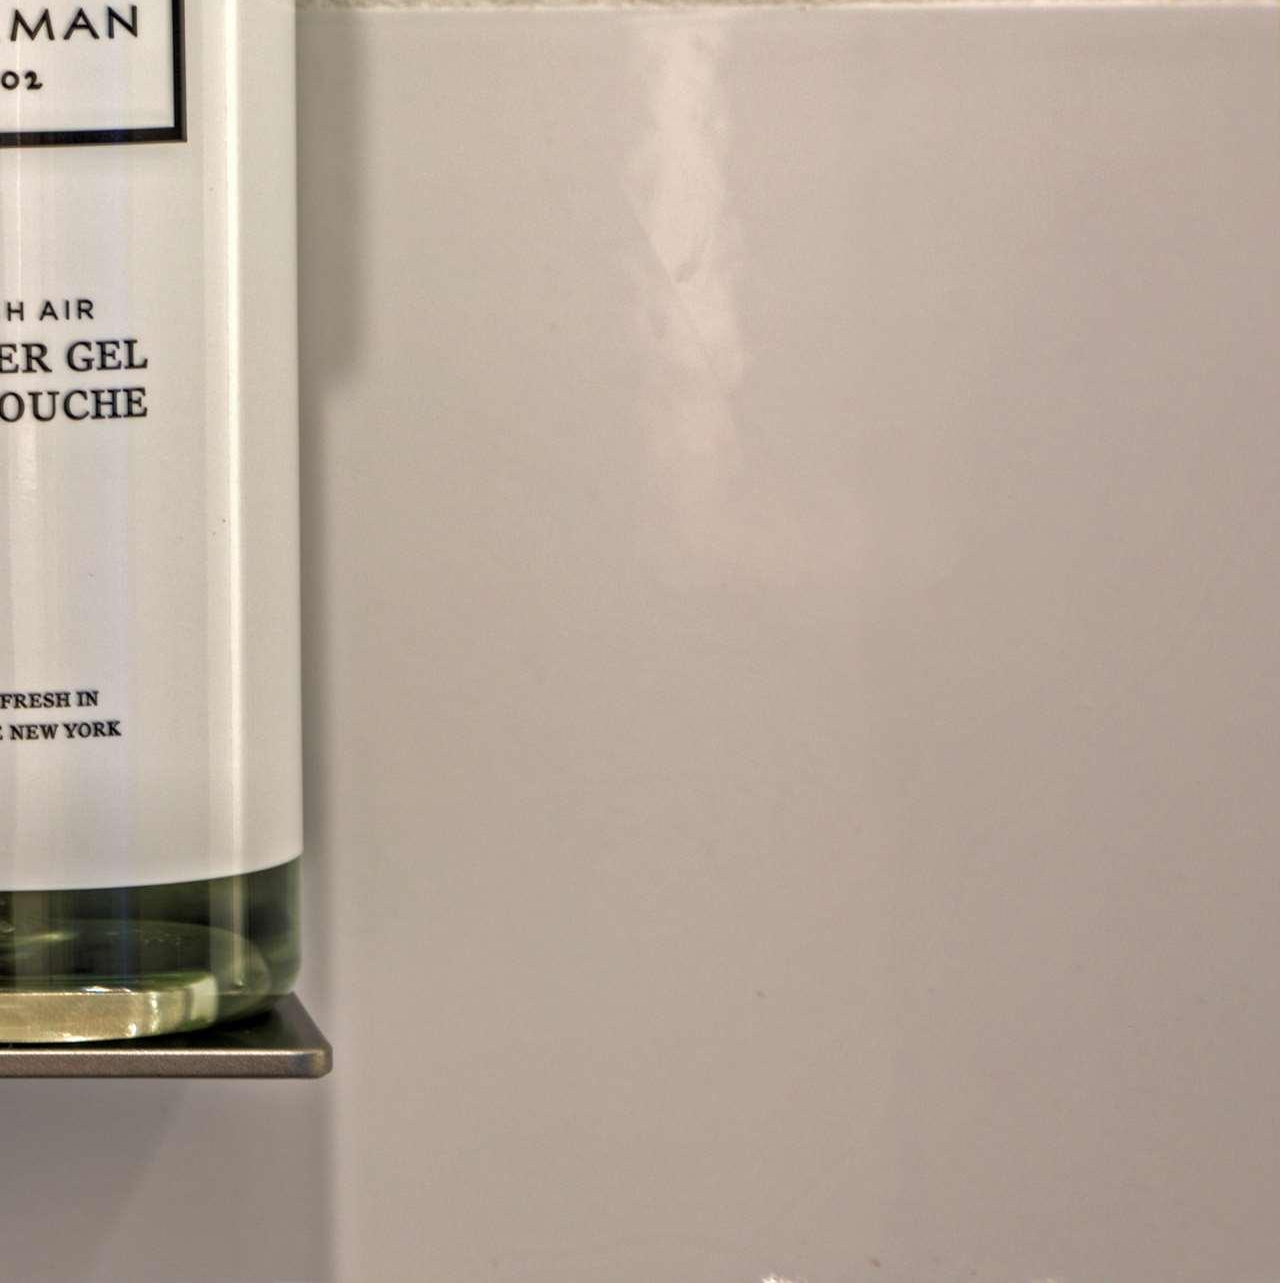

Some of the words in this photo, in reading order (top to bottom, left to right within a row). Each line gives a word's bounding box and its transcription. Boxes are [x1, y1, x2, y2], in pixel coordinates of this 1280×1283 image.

[38, 298, 95, 322] AIR
[64, 338, 149, 373] GEL
[75, 689, 100, 708] IN
[8, 723, 60, 741] NEW
[61, 720, 122, 739] YORK
